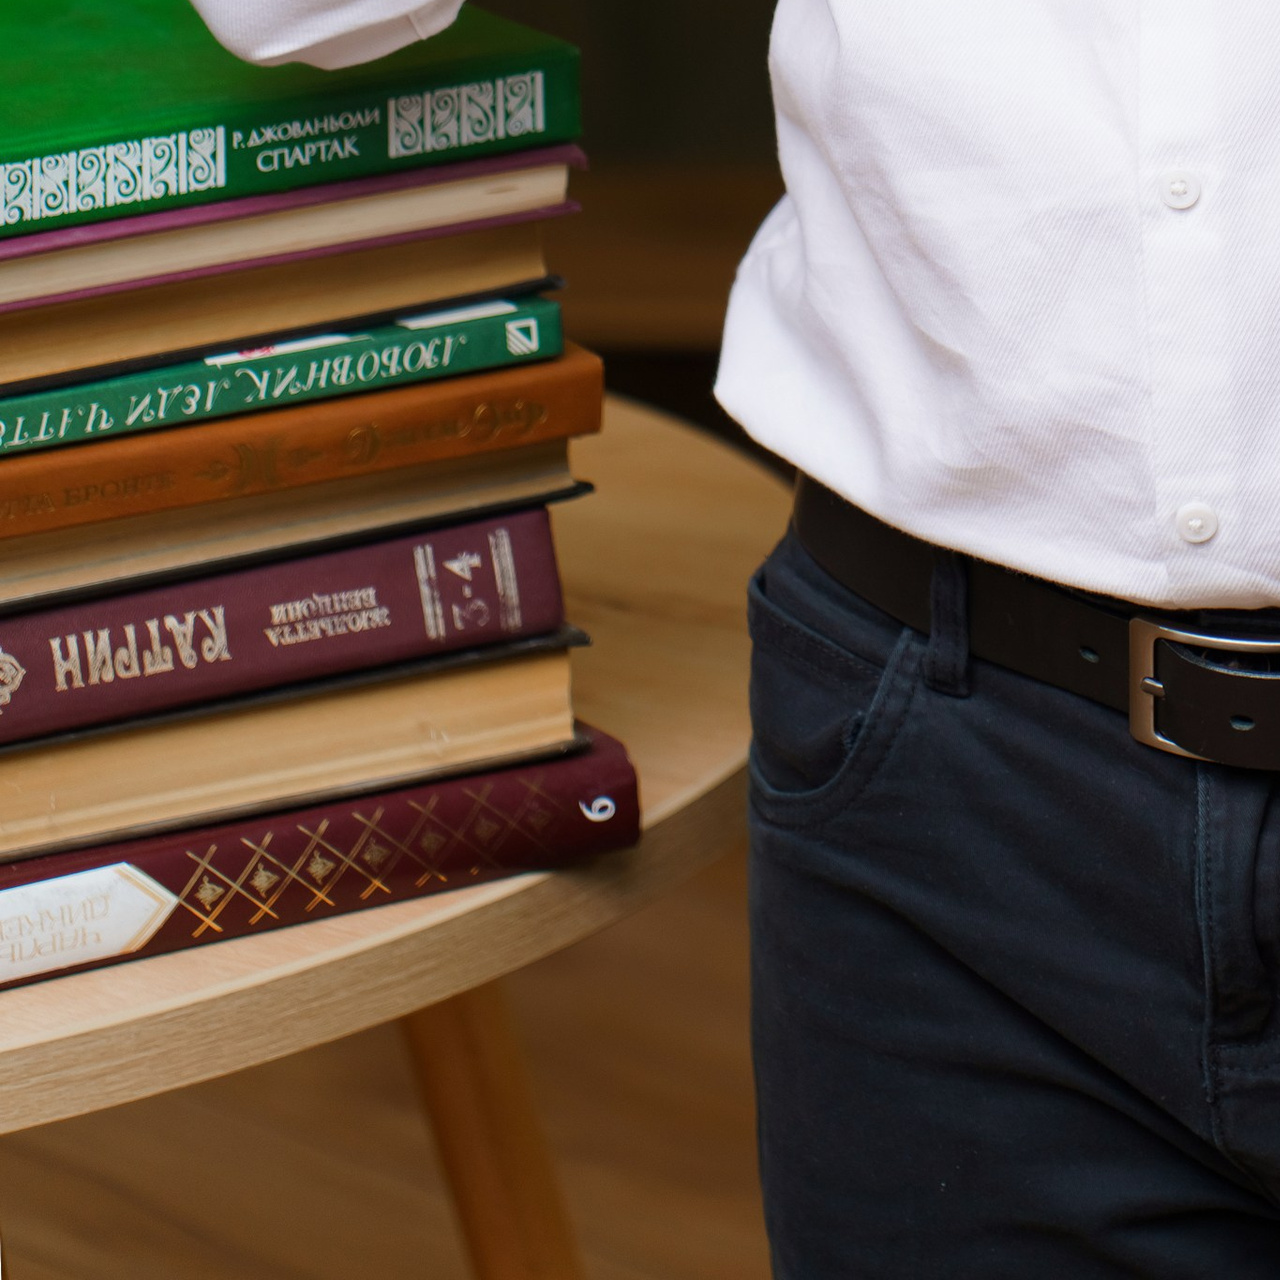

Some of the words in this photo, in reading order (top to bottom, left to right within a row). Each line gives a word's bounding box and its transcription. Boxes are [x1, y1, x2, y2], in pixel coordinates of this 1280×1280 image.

[232, 130, 245, 150] Р.
[247, 106, 380, 148] ДЖОВАНЬОЛИ
[256, 135, 360, 173] СПАРТАК
[234, 334, 468, 403] ЛЮБОВНИК
[124, 377, 232, 427] ЛЕДИ
[269, 586, 378, 625] БЕНЦОНИ
[442, 550, 490, 631] 3-4
[48, 604, 233, 692] КАТРИН
[263, 606, 392, 648] ЖЮЛЬЕТТА
[0, 892, 112, 942] ДИККЕ
